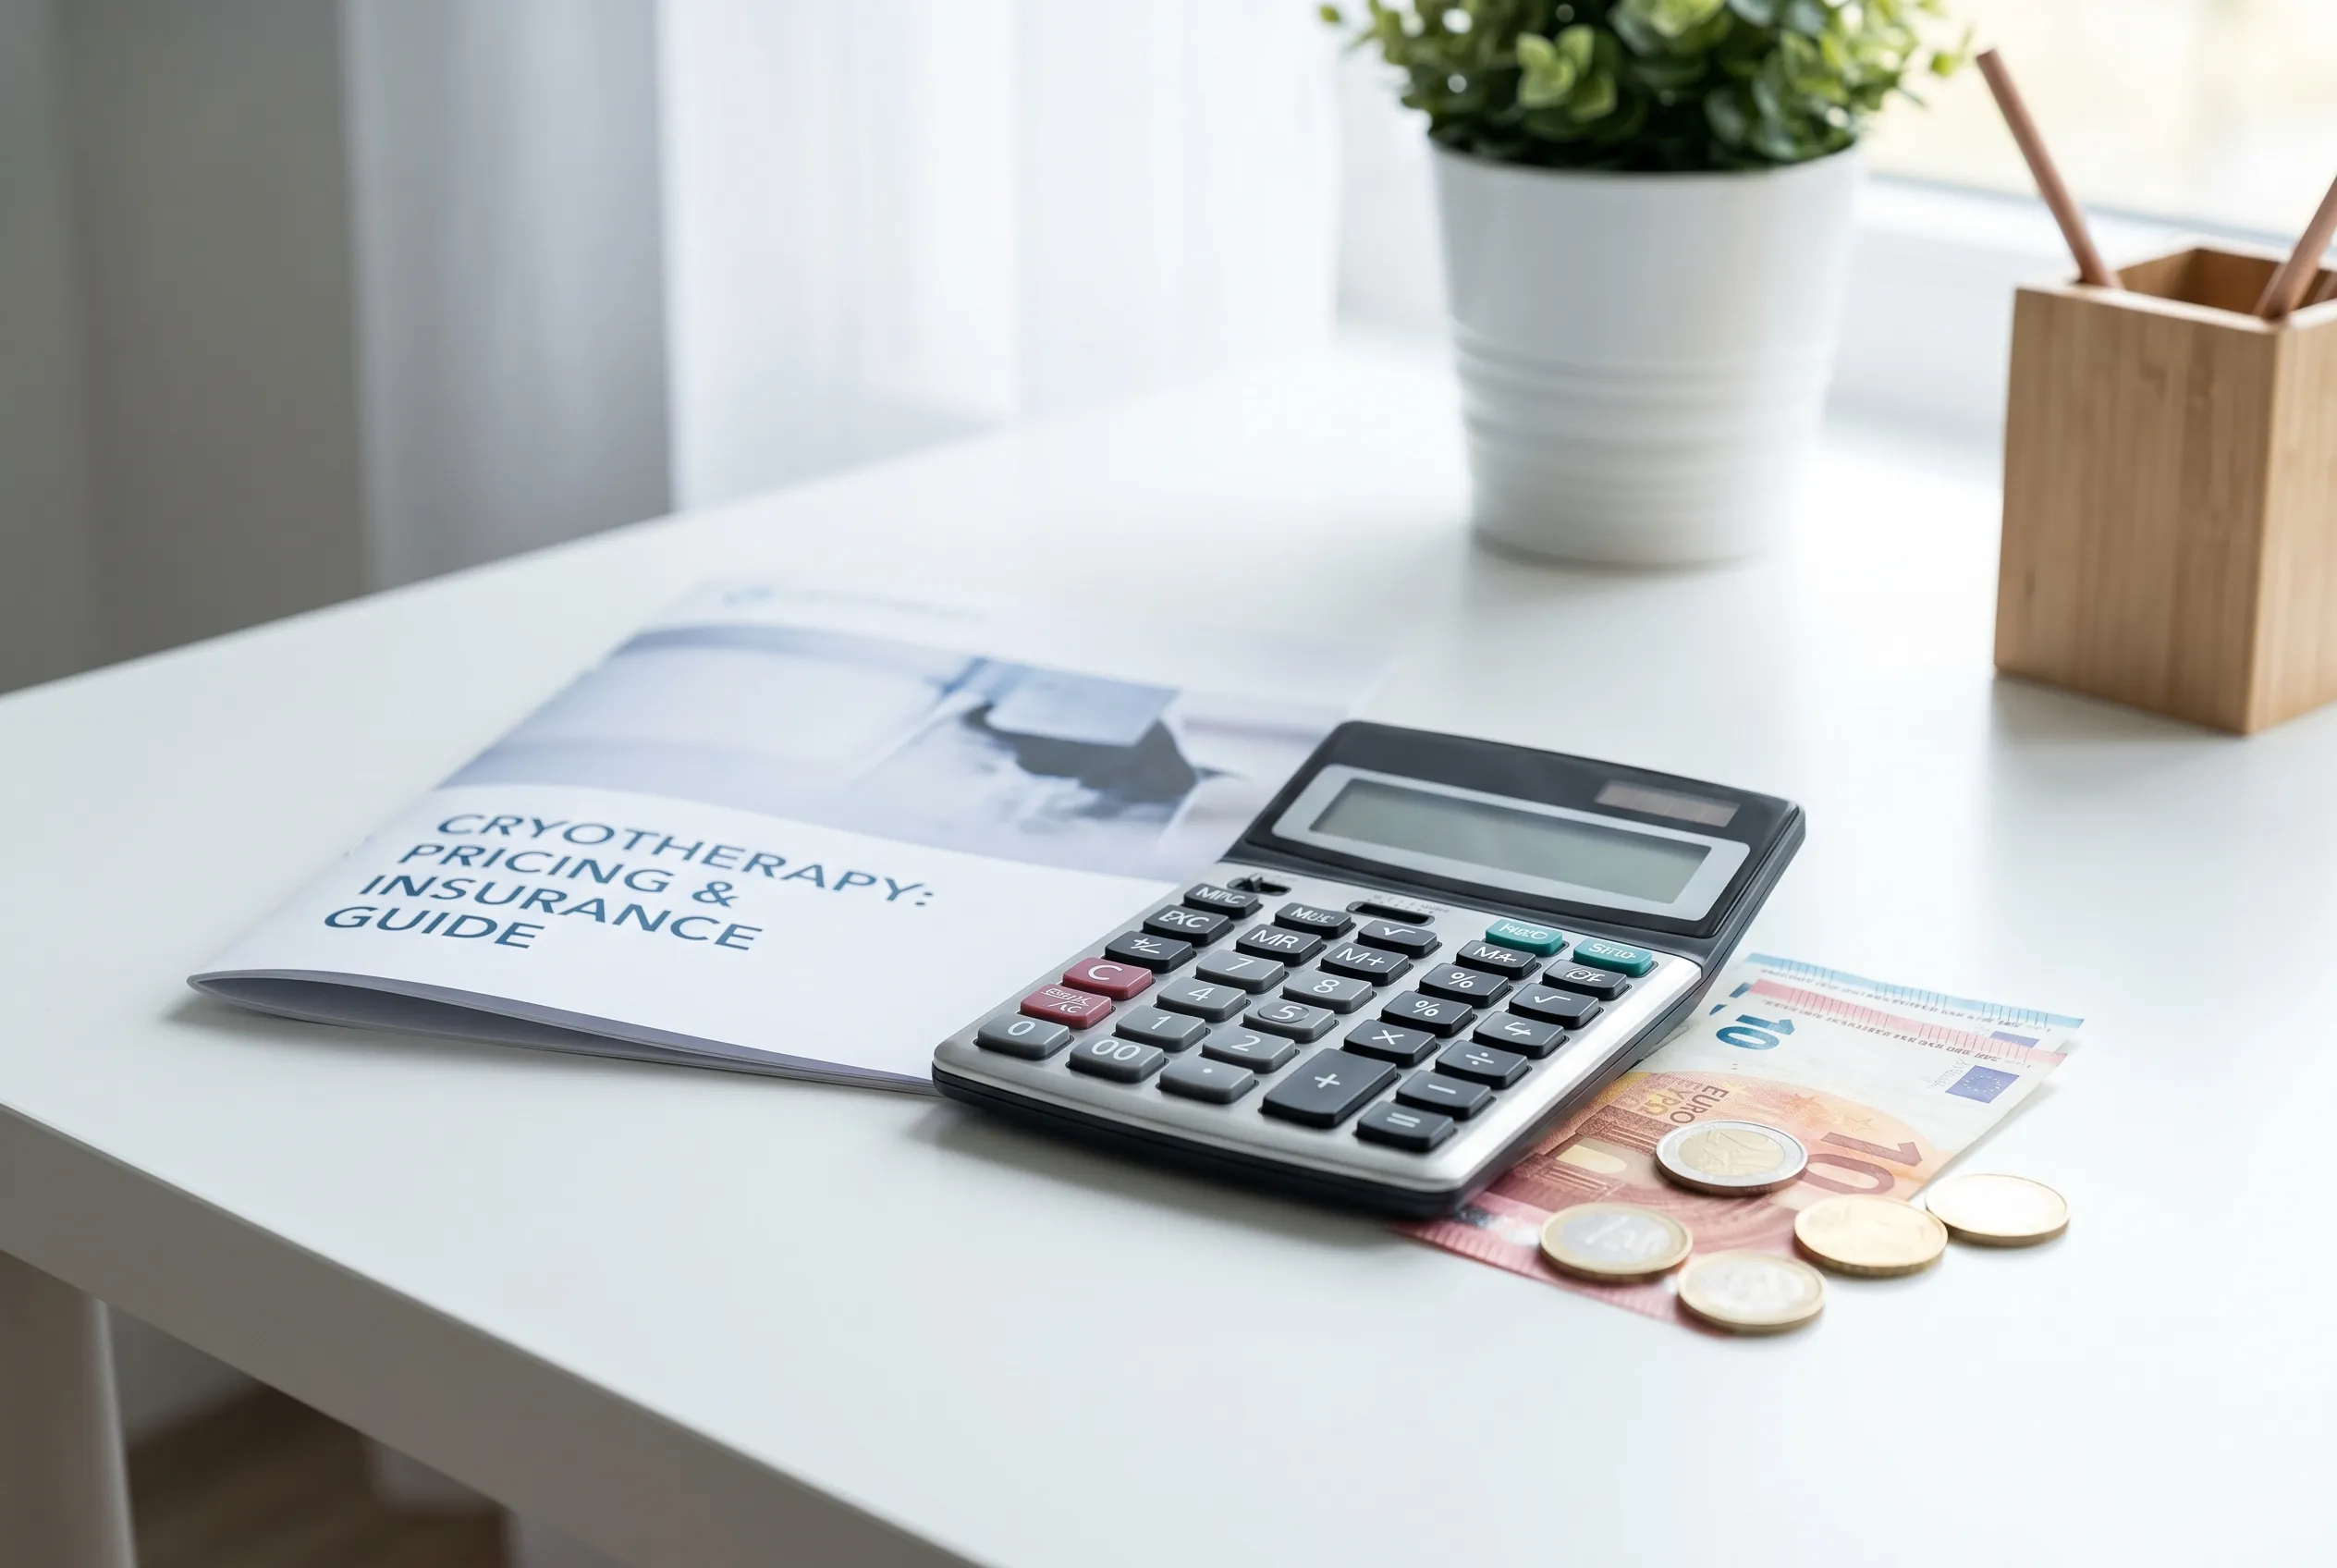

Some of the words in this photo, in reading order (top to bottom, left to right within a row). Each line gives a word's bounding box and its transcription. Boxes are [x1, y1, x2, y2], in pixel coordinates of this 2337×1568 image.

[437, 815, 935, 906] CRYOTHERAPY:
[398, 843, 676, 894] PRICING
[691, 880, 739, 909] &
[359, 875, 764, 951] INSURANCE
[323, 905, 547, 949] GUIDE
[1250, 929, 1300, 949] MR
[1225, 957, 1255, 972] 7
[1336, 947, 1386, 967] M+
[1088, 964, 1123, 981] C
[1448, 972, 1477, 988] %
[1187, 986, 1216, 1001] 4
[1313, 977, 1340, 994] 8
[1271, 1005, 1303, 1020] 5
[1412, 1000, 1440, 1017] %
[1008, 1020, 1036, 1036] 0
[1151, 1015, 1172, 1030] 1
[1716, 1014, 1795, 1050] 10
[1091, 1039, 1142, 1060] 00
[1230, 1035, 1261, 1052] 2
[1669, 1084, 1730, 1124] EURO
[1799, 1132, 1923, 1195] 10
